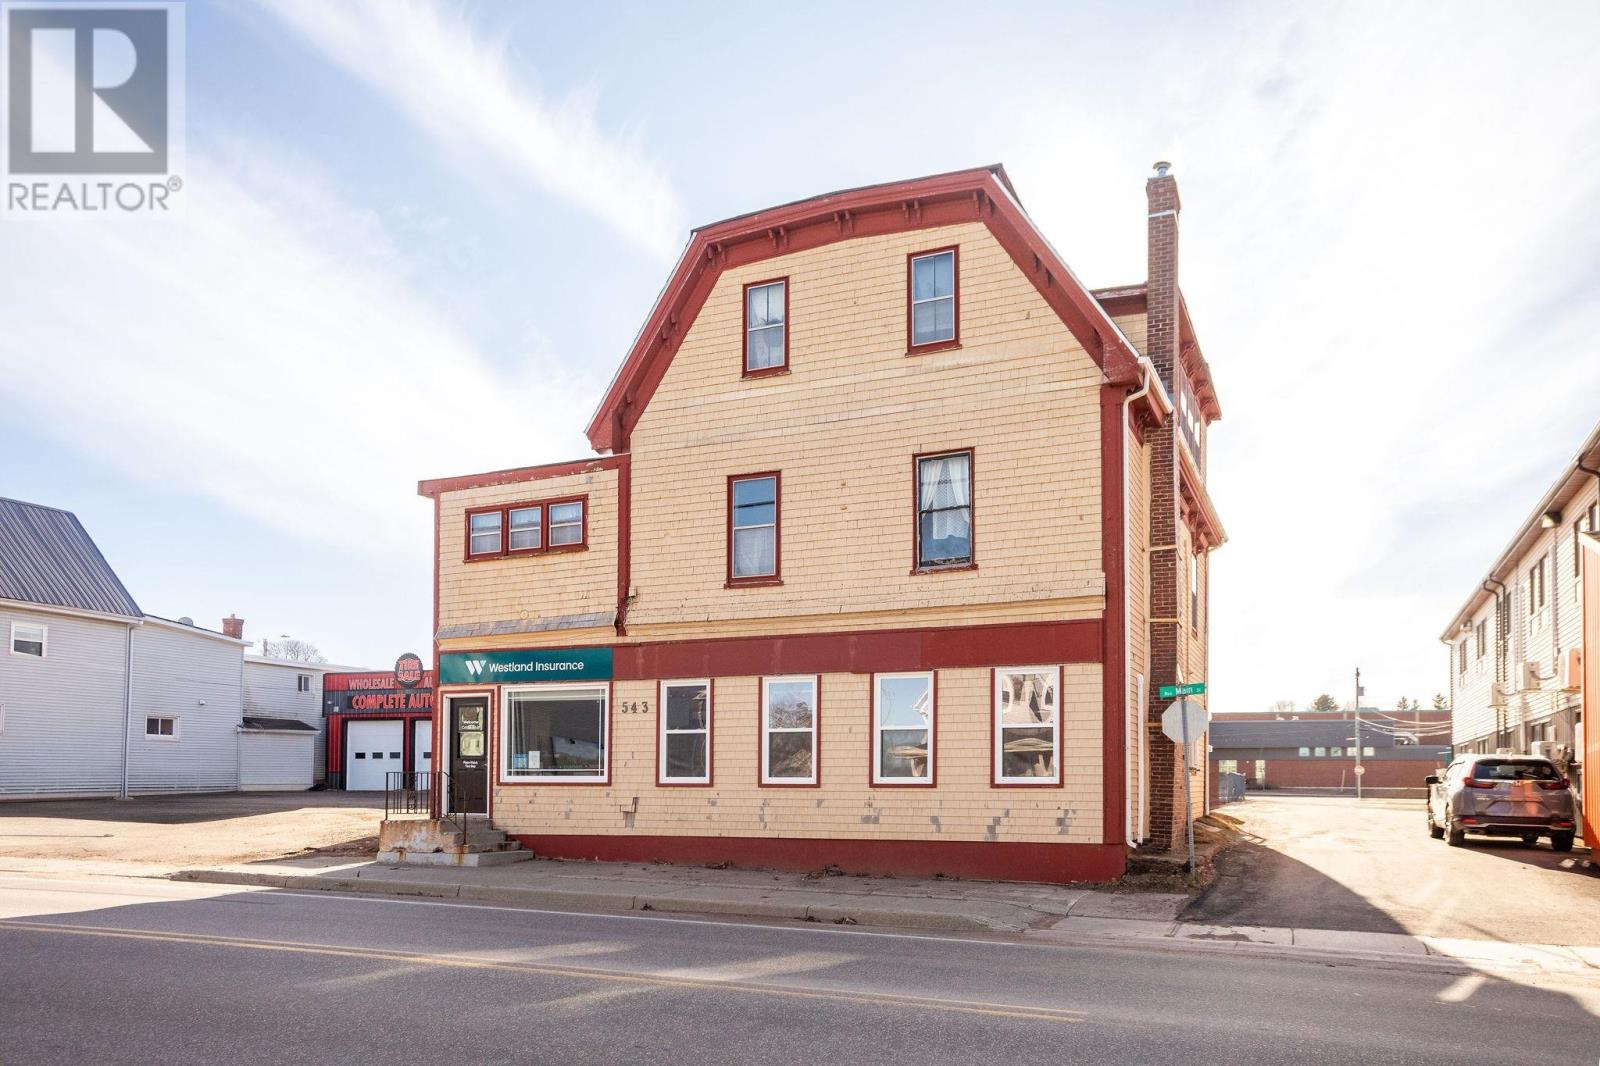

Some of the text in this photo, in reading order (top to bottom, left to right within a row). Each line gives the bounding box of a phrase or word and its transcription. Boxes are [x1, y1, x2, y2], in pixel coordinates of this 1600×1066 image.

[489, 661, 584, 673] Westland Insurance
[348, 678, 394, 690] WHOLESALE
[1175, 687, 1193, 695] Main
[352, 693, 407, 709] COMPLETE
[621, 701, 649, 713] 543
